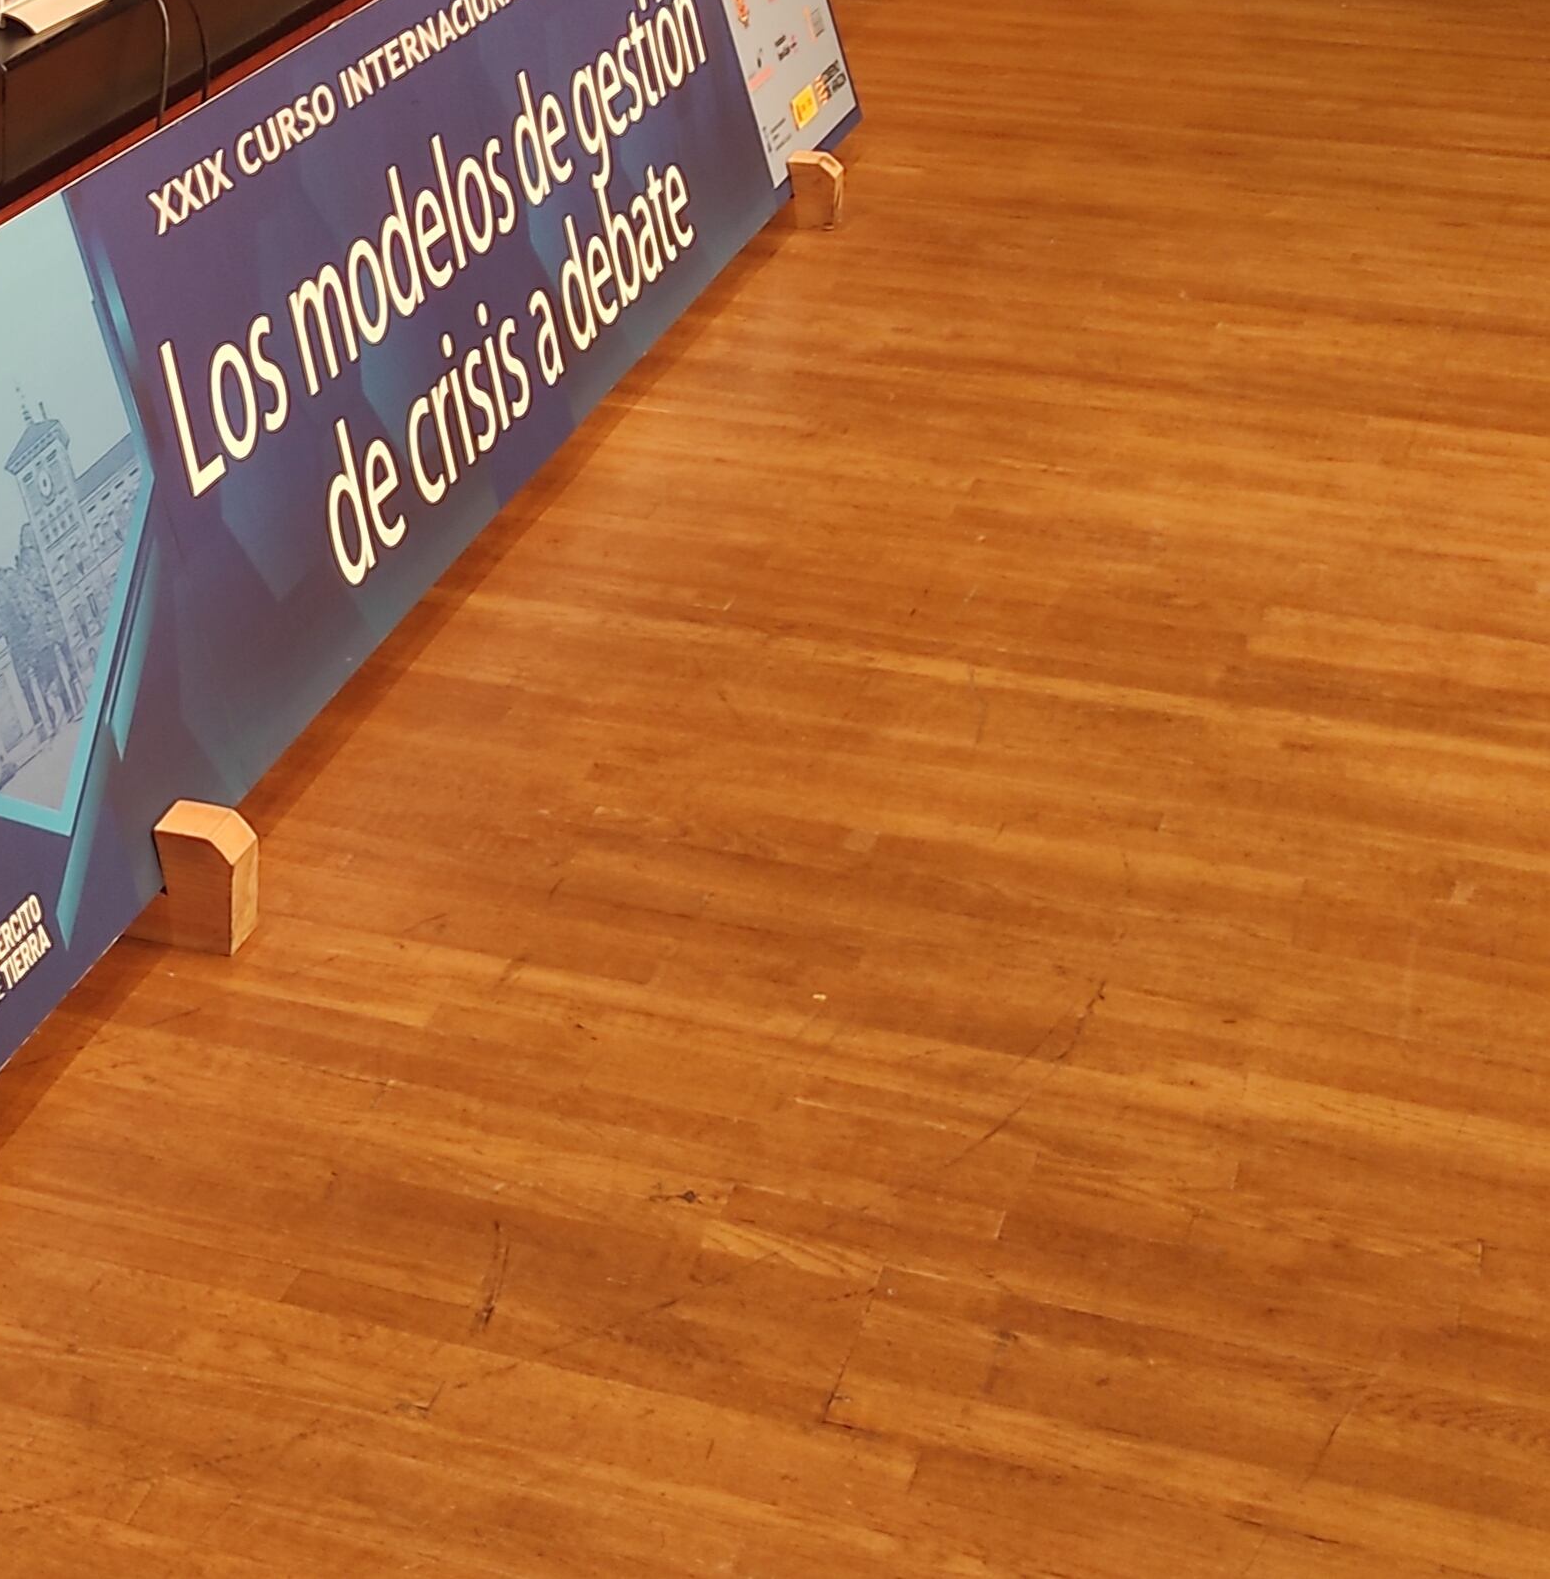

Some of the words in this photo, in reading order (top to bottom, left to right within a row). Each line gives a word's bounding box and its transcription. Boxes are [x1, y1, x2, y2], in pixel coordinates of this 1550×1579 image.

[147, 149, 234, 236] XXIX
[234, 85, 336, 176] CURSO
[159, 313, 289, 497] Los
[288, 134, 517, 397] modelos
[513, 71, 574, 206] de
[326, 418, 407, 587] de
[407, 301, 533, 505] crisis
[528, 287, 565, 386] a
[559, 163, 696, 351] debate
